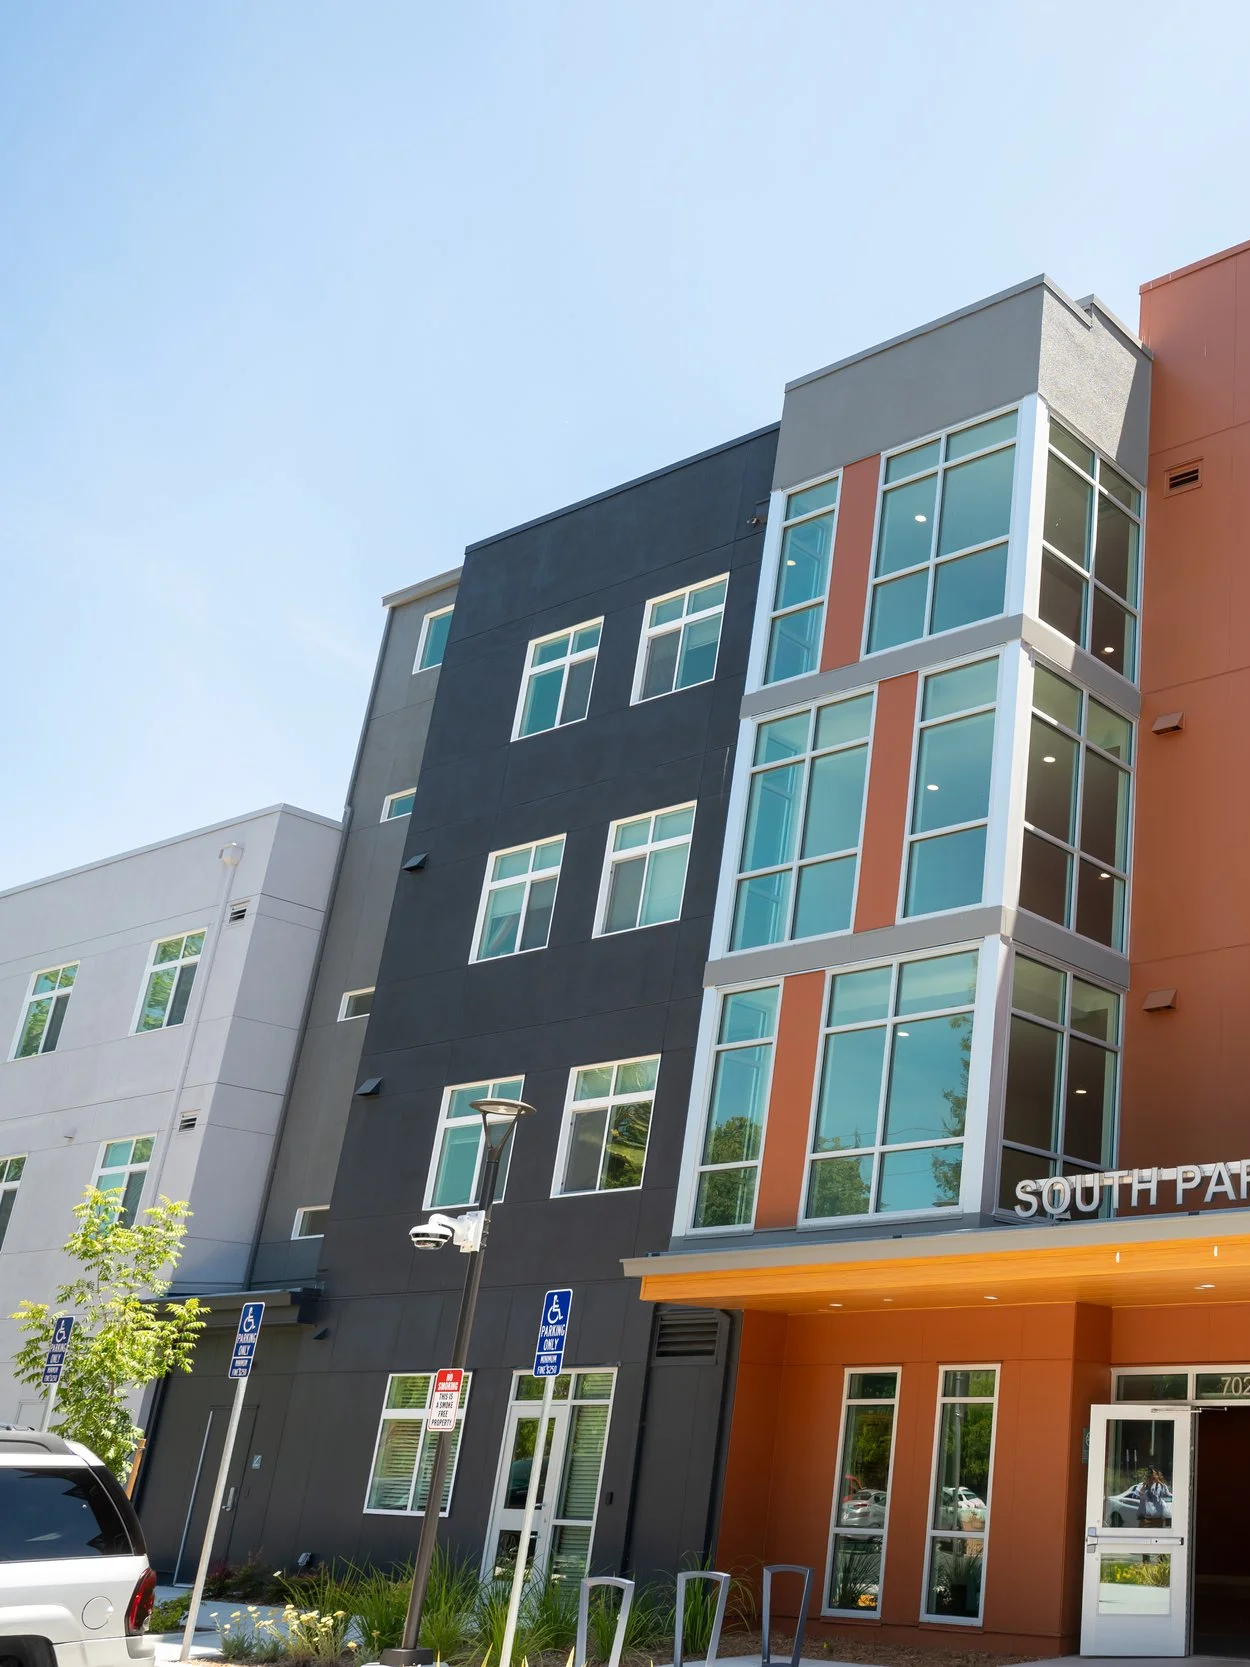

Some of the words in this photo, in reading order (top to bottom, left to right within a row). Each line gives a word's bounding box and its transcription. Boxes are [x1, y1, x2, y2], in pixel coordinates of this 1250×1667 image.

[1014, 1166, 1159, 1218] SOUTH
[540, 1324, 566, 1338] PARKING
[236, 1332, 258, 1344] PARKING
[543, 1338, 560, 1351] ONLY
[238, 1344, 251, 1356] ONLY
[540, 1355, 558, 1364] MINIMUM
[536, 1366, 546, 1375] FINE
[545, 1364, 557, 1375] $250
[445, 1373, 454, 1382] NO
[437, 1381, 459, 1391] SMOKING
[439, 1401, 454, 1409] SMOKE
[437, 1410, 448, 1418] FREE
[431, 1418, 452, 1427] PROPERTY
